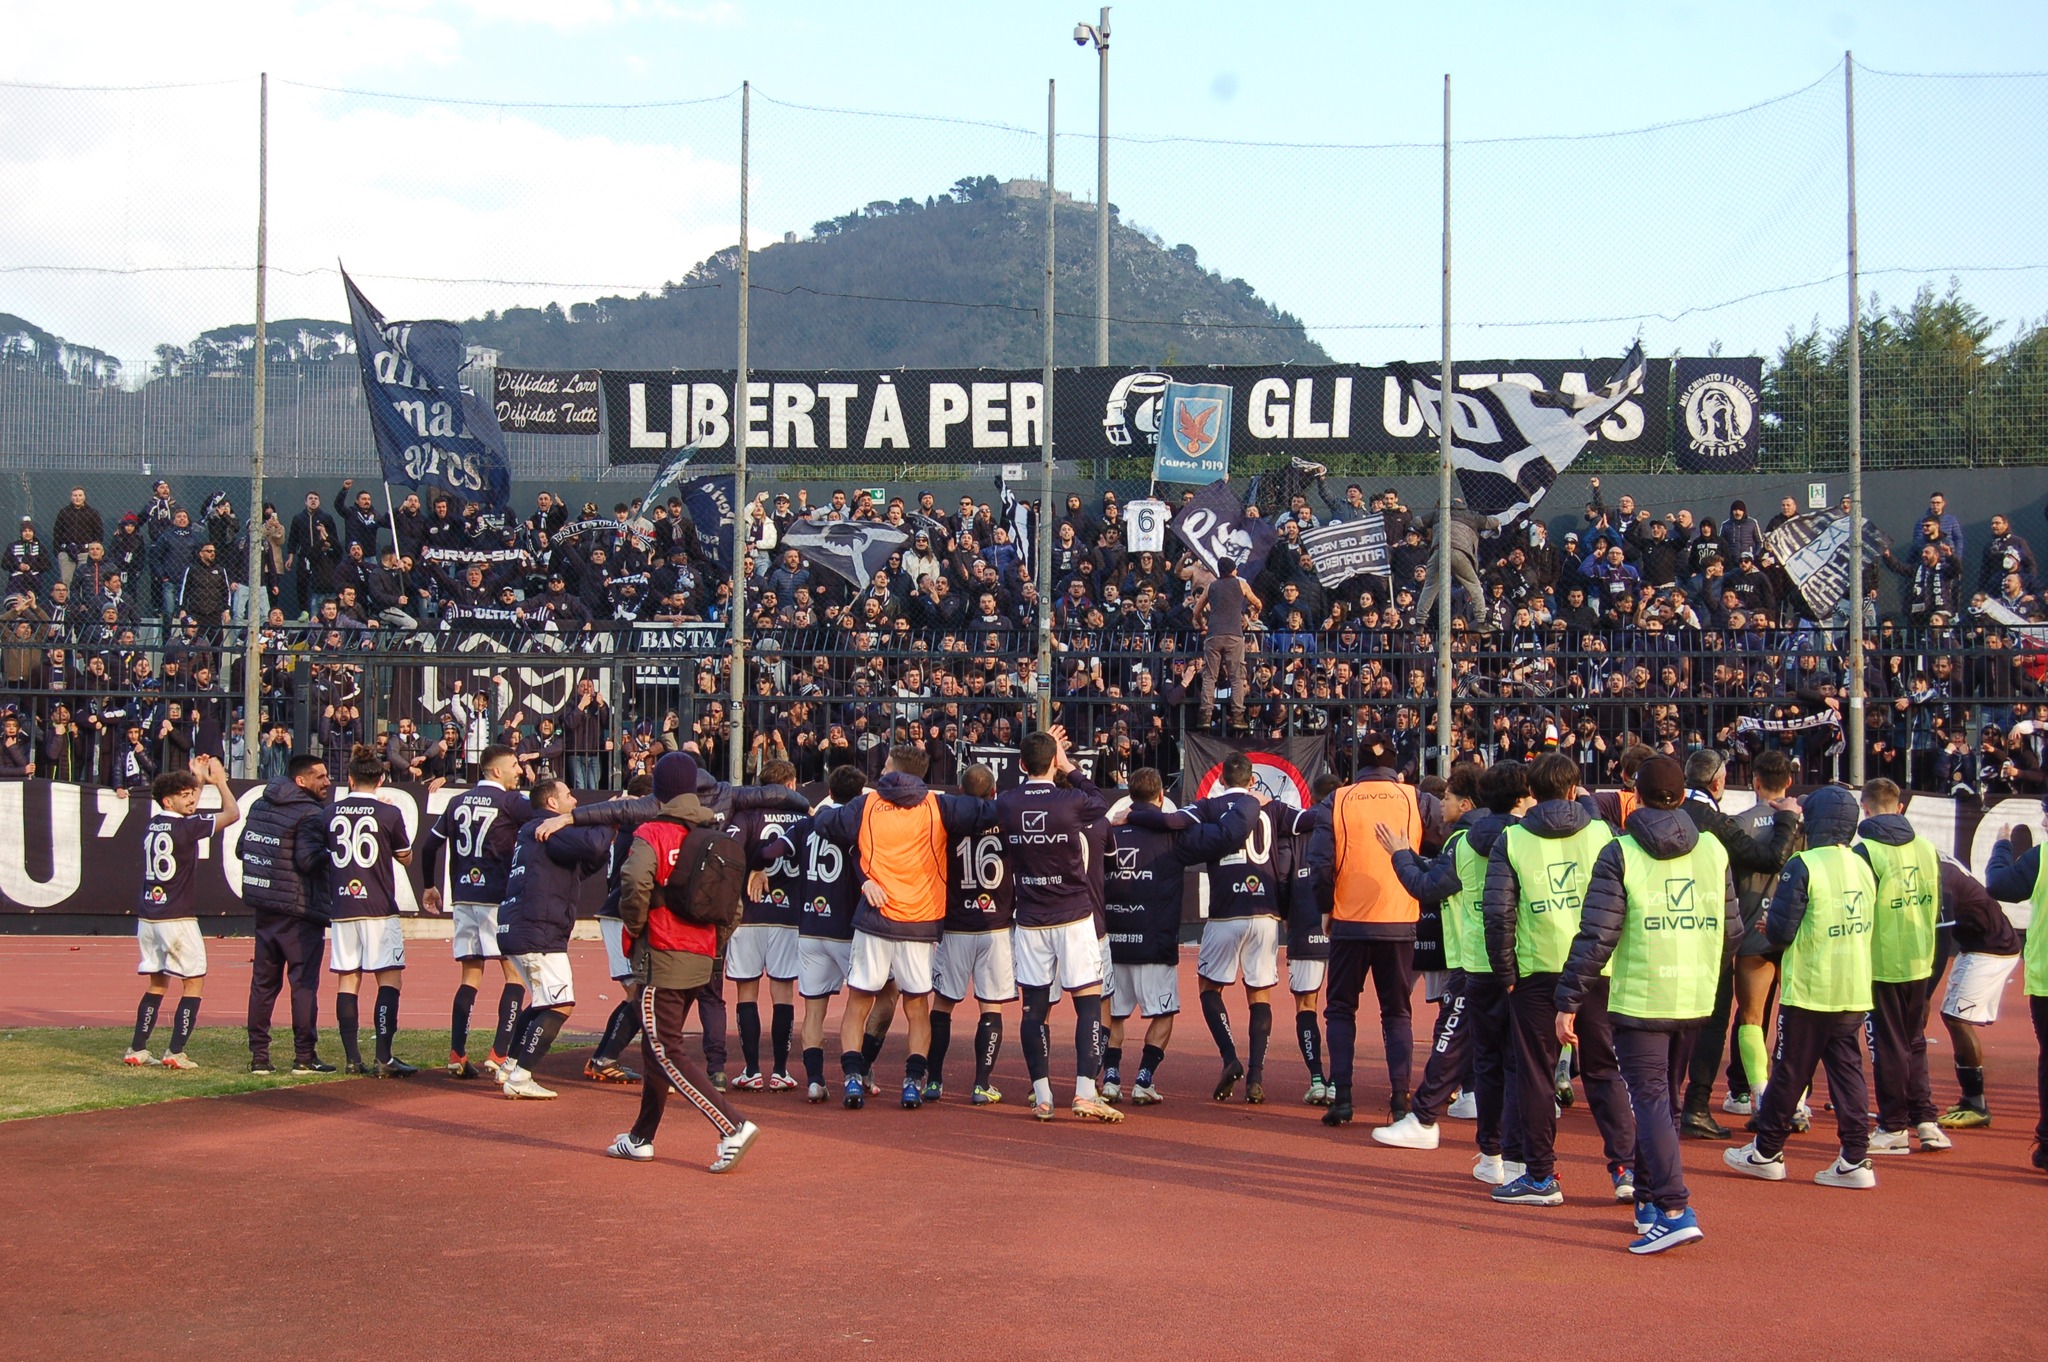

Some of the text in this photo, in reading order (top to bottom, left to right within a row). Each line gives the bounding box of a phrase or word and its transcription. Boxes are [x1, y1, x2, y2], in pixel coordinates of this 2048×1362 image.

[498, 371, 559, 397] Diffidati
[561, 374, 597, 393] Loro
[1679, 392, 1691, 408] MAI
[1687, 373, 1721, 393] CHINATO
[1723, 374, 1735, 385] LA
[496, 401, 597, 427] Diffidati Tutti
[629, 375, 910, 448] LIBERTÀ
[929, 383, 1056, 447] PER
[1248, 377, 1353, 438] GLI
[1689, 439, 1747, 457] ULTRAS
[1160, 456, 1224, 471] Cavese 1919
[1138, 508, 1155, 532] 6
[641, 631, 716, 648] BASTA
[1357, 792, 1405, 800] GIVOVA
[335, 805, 375, 815] LOMASTO
[253, 833, 280, 846] GIVOVA
[454, 805, 499, 857] 37
[1009, 834, 1069, 844] GIVOVA
[329, 815, 379, 869] 36
[144, 831, 176, 881] 18
[806, 831, 843, 883] 15
[956, 835, 1004, 890] 16
[1021, 876, 1047, 886] cavese
[1530, 895, 1581, 914] GIVO
[1644, 916, 1718, 931] GIVOVA
[1828, 921, 1872, 938] GIVOVA
[1128, 933, 1144, 943] 1919
[1308, 934, 1330, 944] cave
[1420, 940, 1436, 950] 1919
[1435, 996, 1466, 1053] GIVOVA
[1776, 1014, 1784, 1060] GIVOVA
